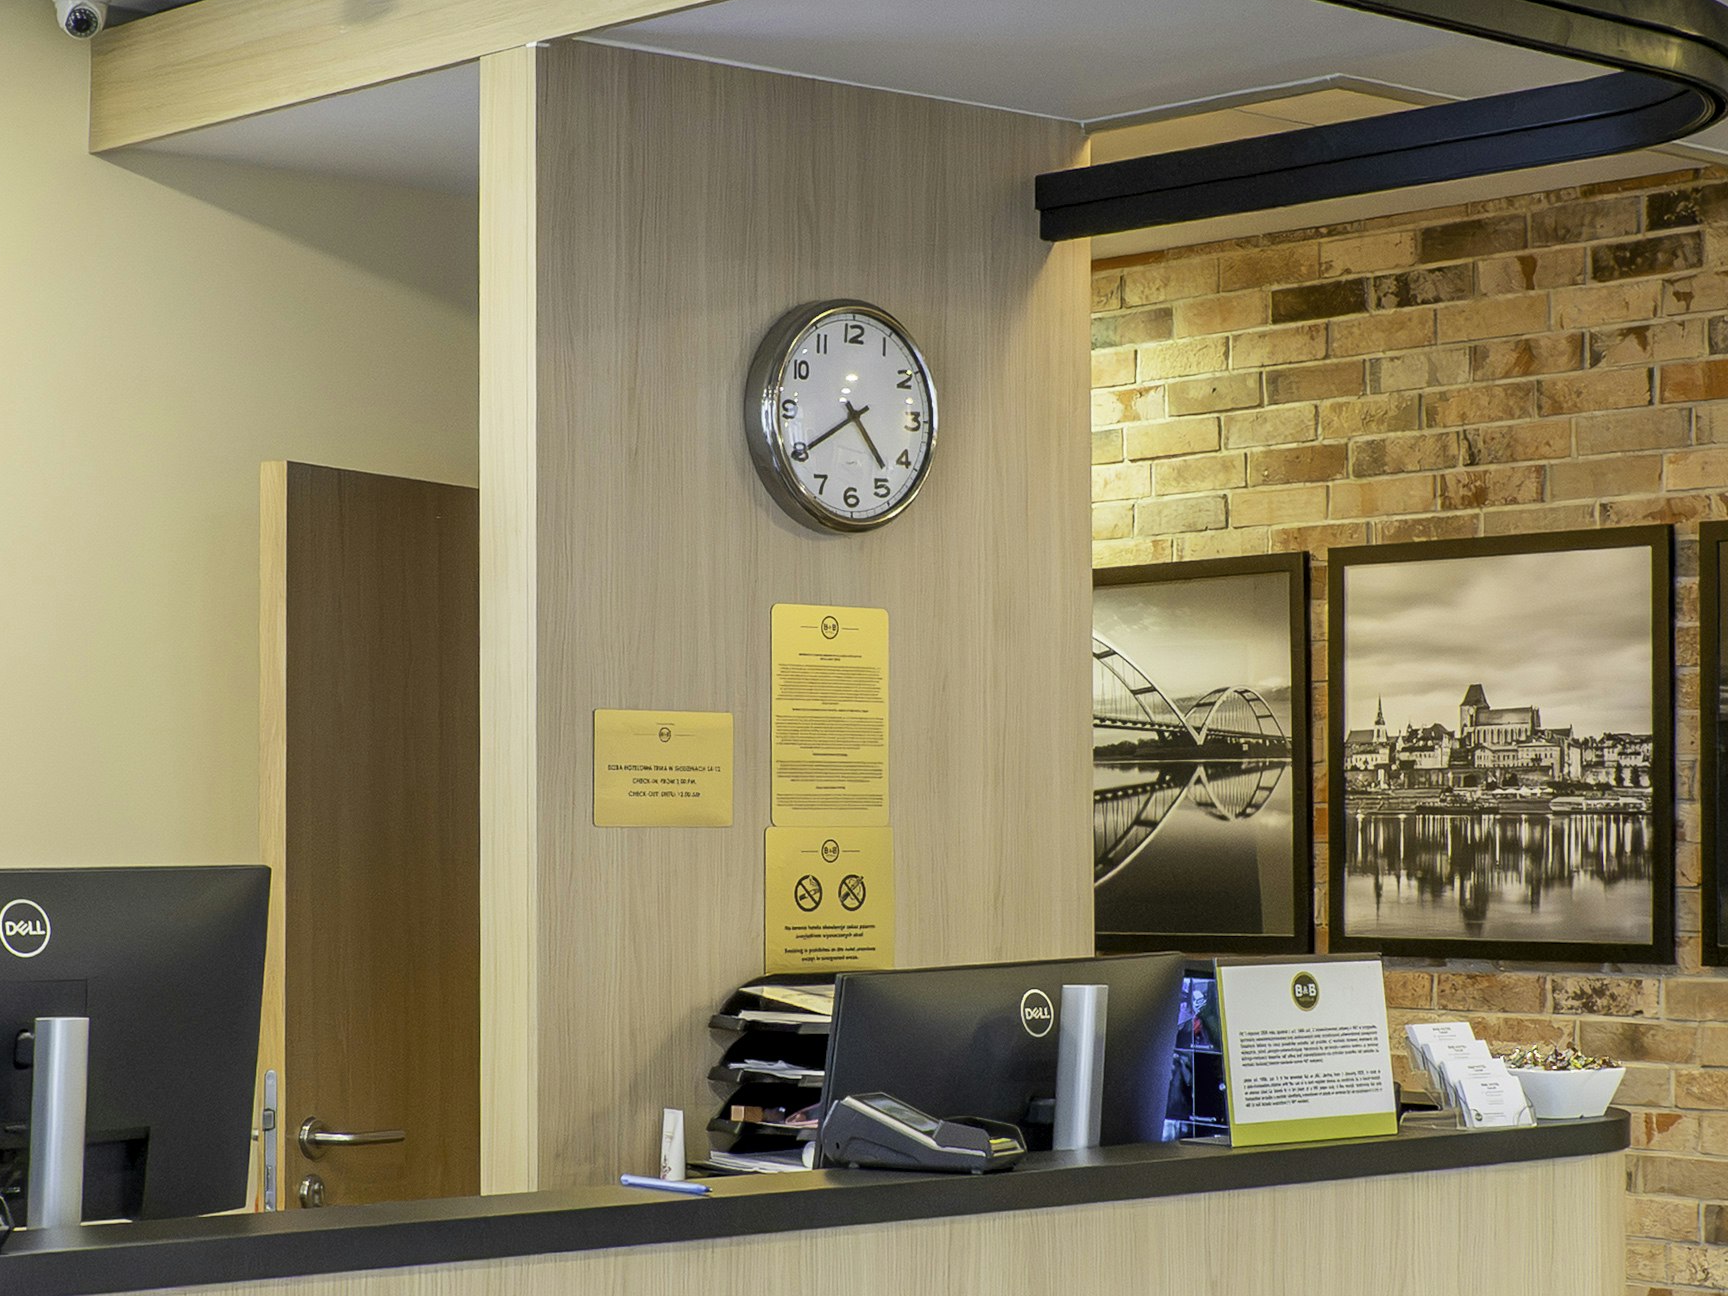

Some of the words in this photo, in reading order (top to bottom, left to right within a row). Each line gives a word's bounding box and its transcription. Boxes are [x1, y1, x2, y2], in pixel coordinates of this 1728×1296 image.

[816, 334, 827, 354] 11
[844, 323, 865, 345] 12
[882, 337, 887, 357] 1
[794, 359, 810, 380] 10
[896, 369, 913, 390] 2
[781, 399, 798, 420] 9
[904, 411, 921, 432] 3
[790, 441, 809, 463] 8
[896, 449, 912, 469] 4
[813, 473, 829, 495] 7
[873, 478, 891, 499] 5
[843, 487, 860, 508] 6
[5, 920, 46, 936] DELL
[1294, 983, 1317, 997] B&B
[1025, 1007, 1051, 1020] DELL
